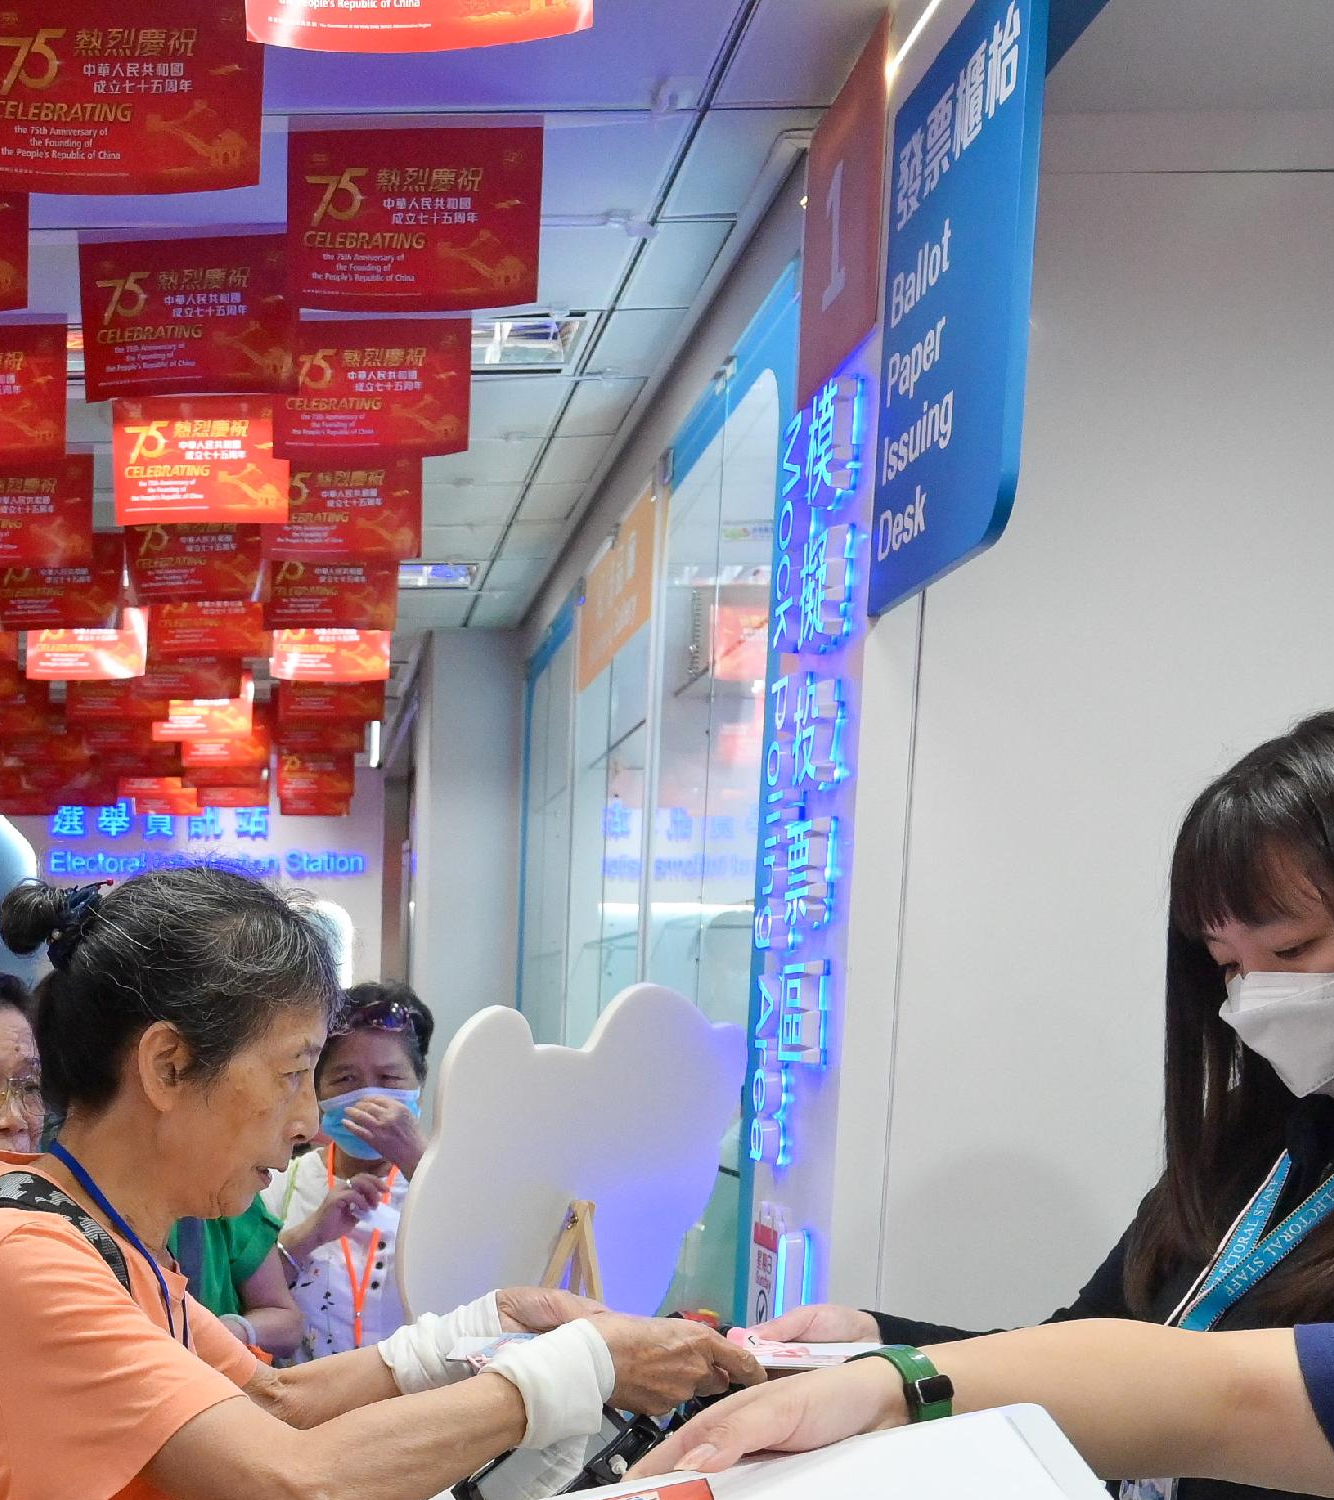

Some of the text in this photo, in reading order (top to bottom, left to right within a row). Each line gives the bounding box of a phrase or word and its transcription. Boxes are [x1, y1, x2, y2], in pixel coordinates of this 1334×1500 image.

[74, 28, 197, 56] 熱烈慶祝
[83, 62, 184, 77] 中華人民共和國
[94, 79, 193, 94] 成立七十五周年
[30, 127, 47, 135] 75th
[50, 127, 97, 137] Anniversary
[100, 128, 108, 136] of
[30, 138, 92, 149] the Founding of
[1, 147, 120, 160] the People's Republic of China
[375, 168, 483, 192] 熱烈慶祝
[304, 168, 369, 226] 75
[383, 197, 471, 210] 中華人民共和國
[392, 212, 478, 225] 成立七十五周年
[302, 231, 426, 249] CELEBRATING
[821, 161, 846, 310] 1
[890, 217, 952, 328] Ballot
[96, 271, 153, 323] 75
[173, 305, 248, 318] 成立七十五周年
[97, 325, 203, 343] CELEBRATING
[886, 315, 946, 408] Paper
[284, 398, 382, 410] CELEBRATING
[174, 420, 248, 438] 熱烈慶祝
[124, 421, 170, 462] 75
[882, 390, 954, 487] Issuing
[124, 465, 210, 477] CELEBRATING
[878, 485, 927, 562] Desk
[50, 851, 146, 873] Electoral
[286, 853, 364, 873] Station
[750, 974, 775, 1161] Area
